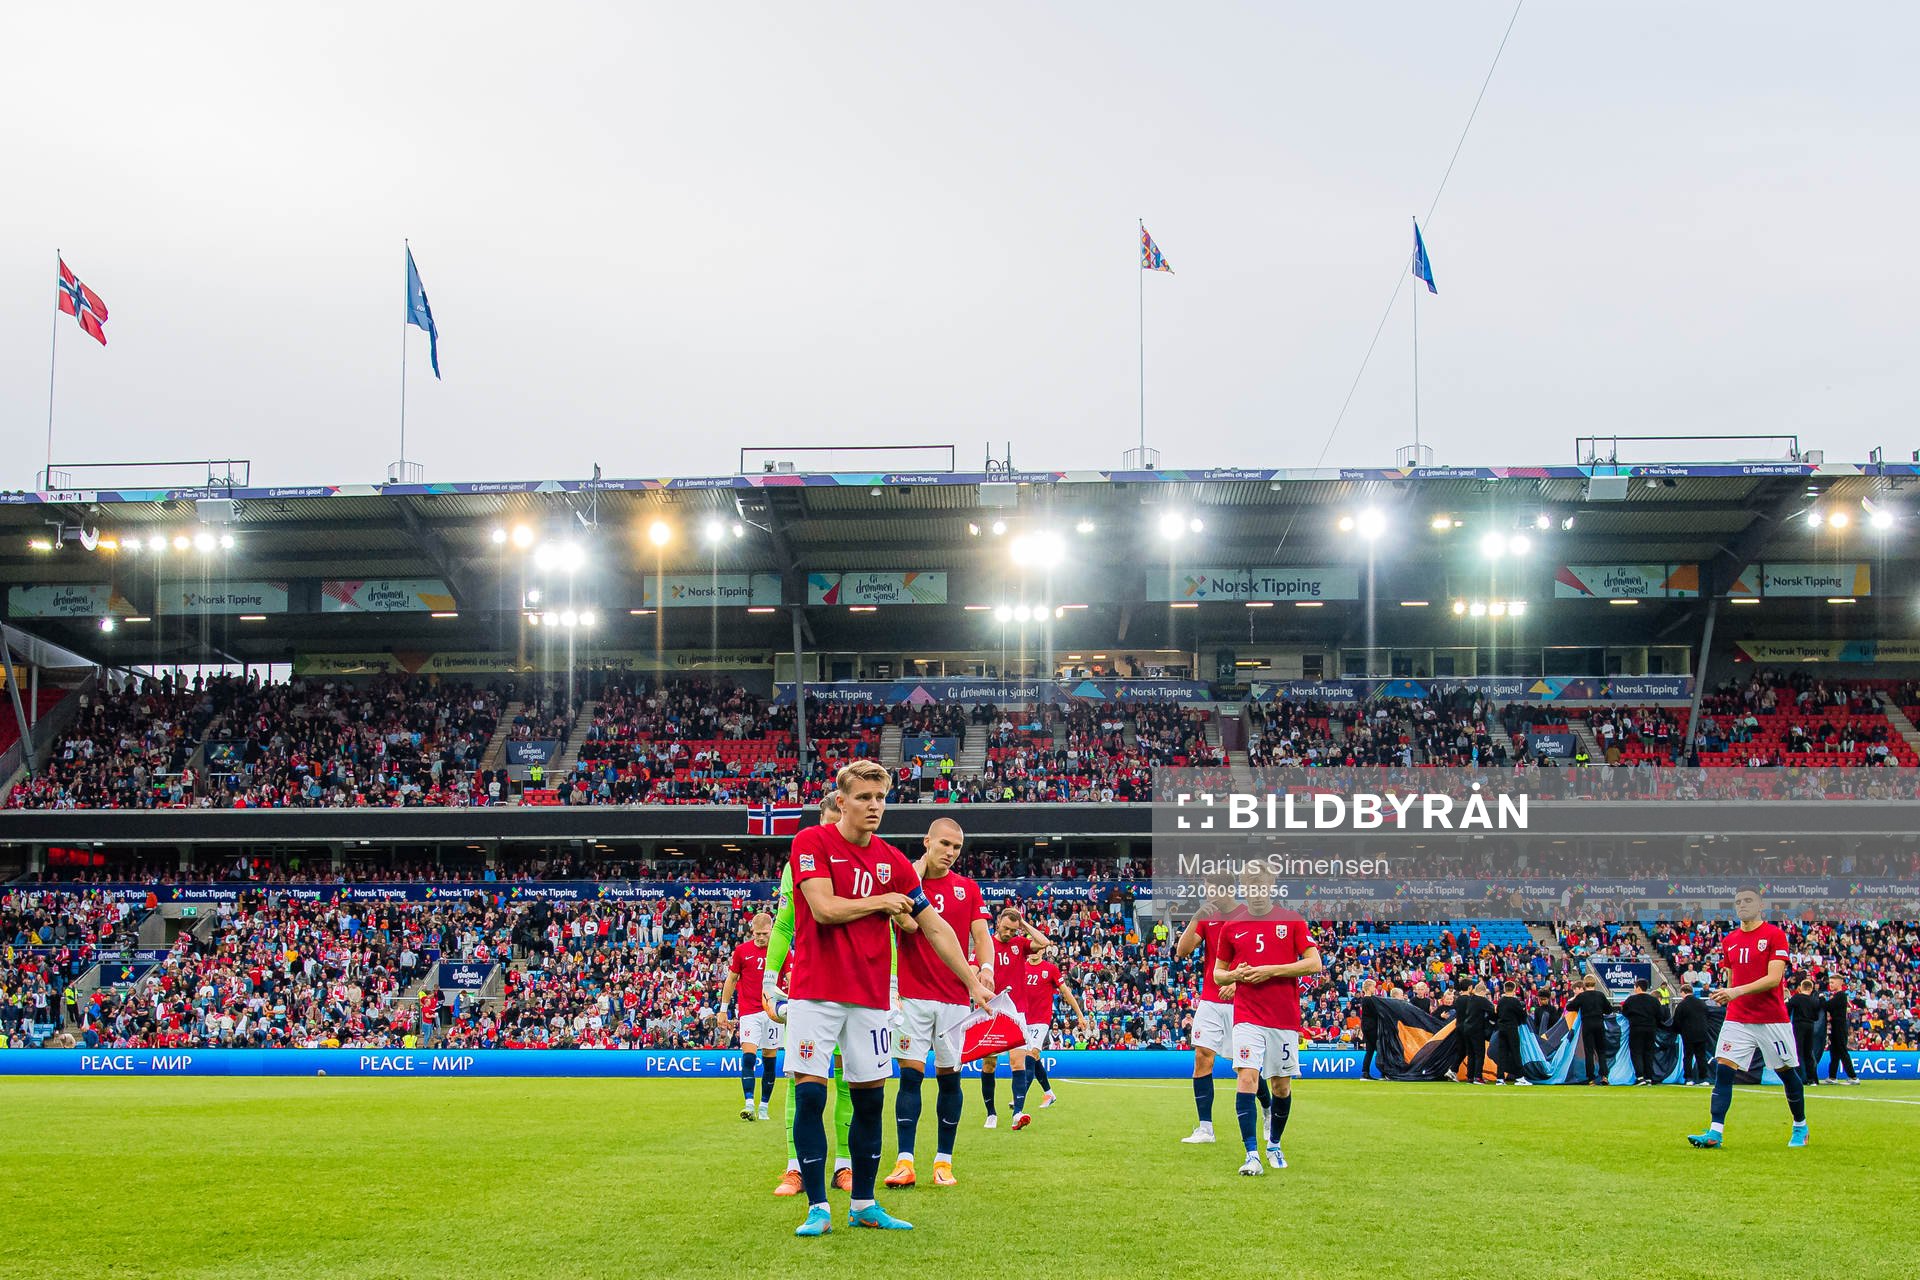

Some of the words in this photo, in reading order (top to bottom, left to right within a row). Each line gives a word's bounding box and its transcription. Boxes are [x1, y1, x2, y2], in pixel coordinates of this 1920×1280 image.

[1618, 568, 1626, 576] Gi
[870, 575, 878, 584] Gi
[1773, 577, 1802, 586] Norsk
[1804, 577, 1841, 587] Tipping
[66, 587, 74, 596] Gi
[718, 587, 754, 597] Tipping
[1212, 579, 1259, 592] Norsk
[1262, 579, 1321, 595] Tipping
[1622, 582, 1648, 597] sjanse!
[198, 595, 225, 603] Norsk
[228, 595, 261, 605] Tipping
[873, 589, 899, 603] sjanse!
[70, 602, 93, 614] sjanse!
[385, 597, 409, 611] sjanse!
[1796, 648, 1829, 657] Tipping
[813, 690, 838, 698] Norsk
[840, 690, 872, 700] Tipping
[948, 688, 957, 698] Gi
[998, 689, 1007, 697] en
[1010, 686, 1039, 699] sjanse!
[1130, 688, 1157, 696] Norsk
[1158, 687, 1192, 698] Tipping
[1292, 687, 1318, 695] Norsk
[1320, 687, 1353, 697] Tipping
[1493, 683, 1522, 696] sjanse!
[1616, 684, 1642, 693] Norsk
[1644, 684, 1678, 695] Tipping
[853, 868, 873, 897] 10
[208, 890, 236, 899] Tipping
[292, 890, 320, 898] Tipping
[377, 890, 406, 899] Tipping
[549, 889, 577, 898] Tipping
[636, 888, 664, 898] Tipping
[986, 888, 1016, 896] Tipping
[1320, 887, 1343, 895] Norsk
[1344, 887, 1374, 896] Tipping
[1410, 886, 1433, 895] Norsk
[1434, 886, 1464, 896] Tipping
[1525, 886, 1555, 895] Tipping
[1591, 886, 1615, 894] Norsk
[1615, 886, 1646, 895] Tipping
[1682, 885, 1705, 893] Norsk
[1707, 885, 1736, 895] Tipping
[1798, 885, 1828, 895] Tipping
[1889, 885, 1919, 895] Tipping
[934, 894, 944, 913] 3
[1256, 934, 1264, 952] 5
[998, 952, 1010, 965] 16
[1740, 948, 1749, 963] 11
[757, 958, 767, 969] 2
[1027, 975, 1038, 985] 22
[768, 1028, 778, 1039] 21
[870, 1028, 890, 1055] 10
[1282, 1044, 1290, 1060] 5
[1774, 1041, 1787, 1055] 11
[82, 1056, 134, 1070] PEACE
[152, 1056, 192, 1070] МИР
[360, 1056, 414, 1070] PEACE
[432, 1057, 474, 1070] МИР
[646, 1057, 701, 1071] PEACE
[1312, 1058, 1355, 1072] МИР
